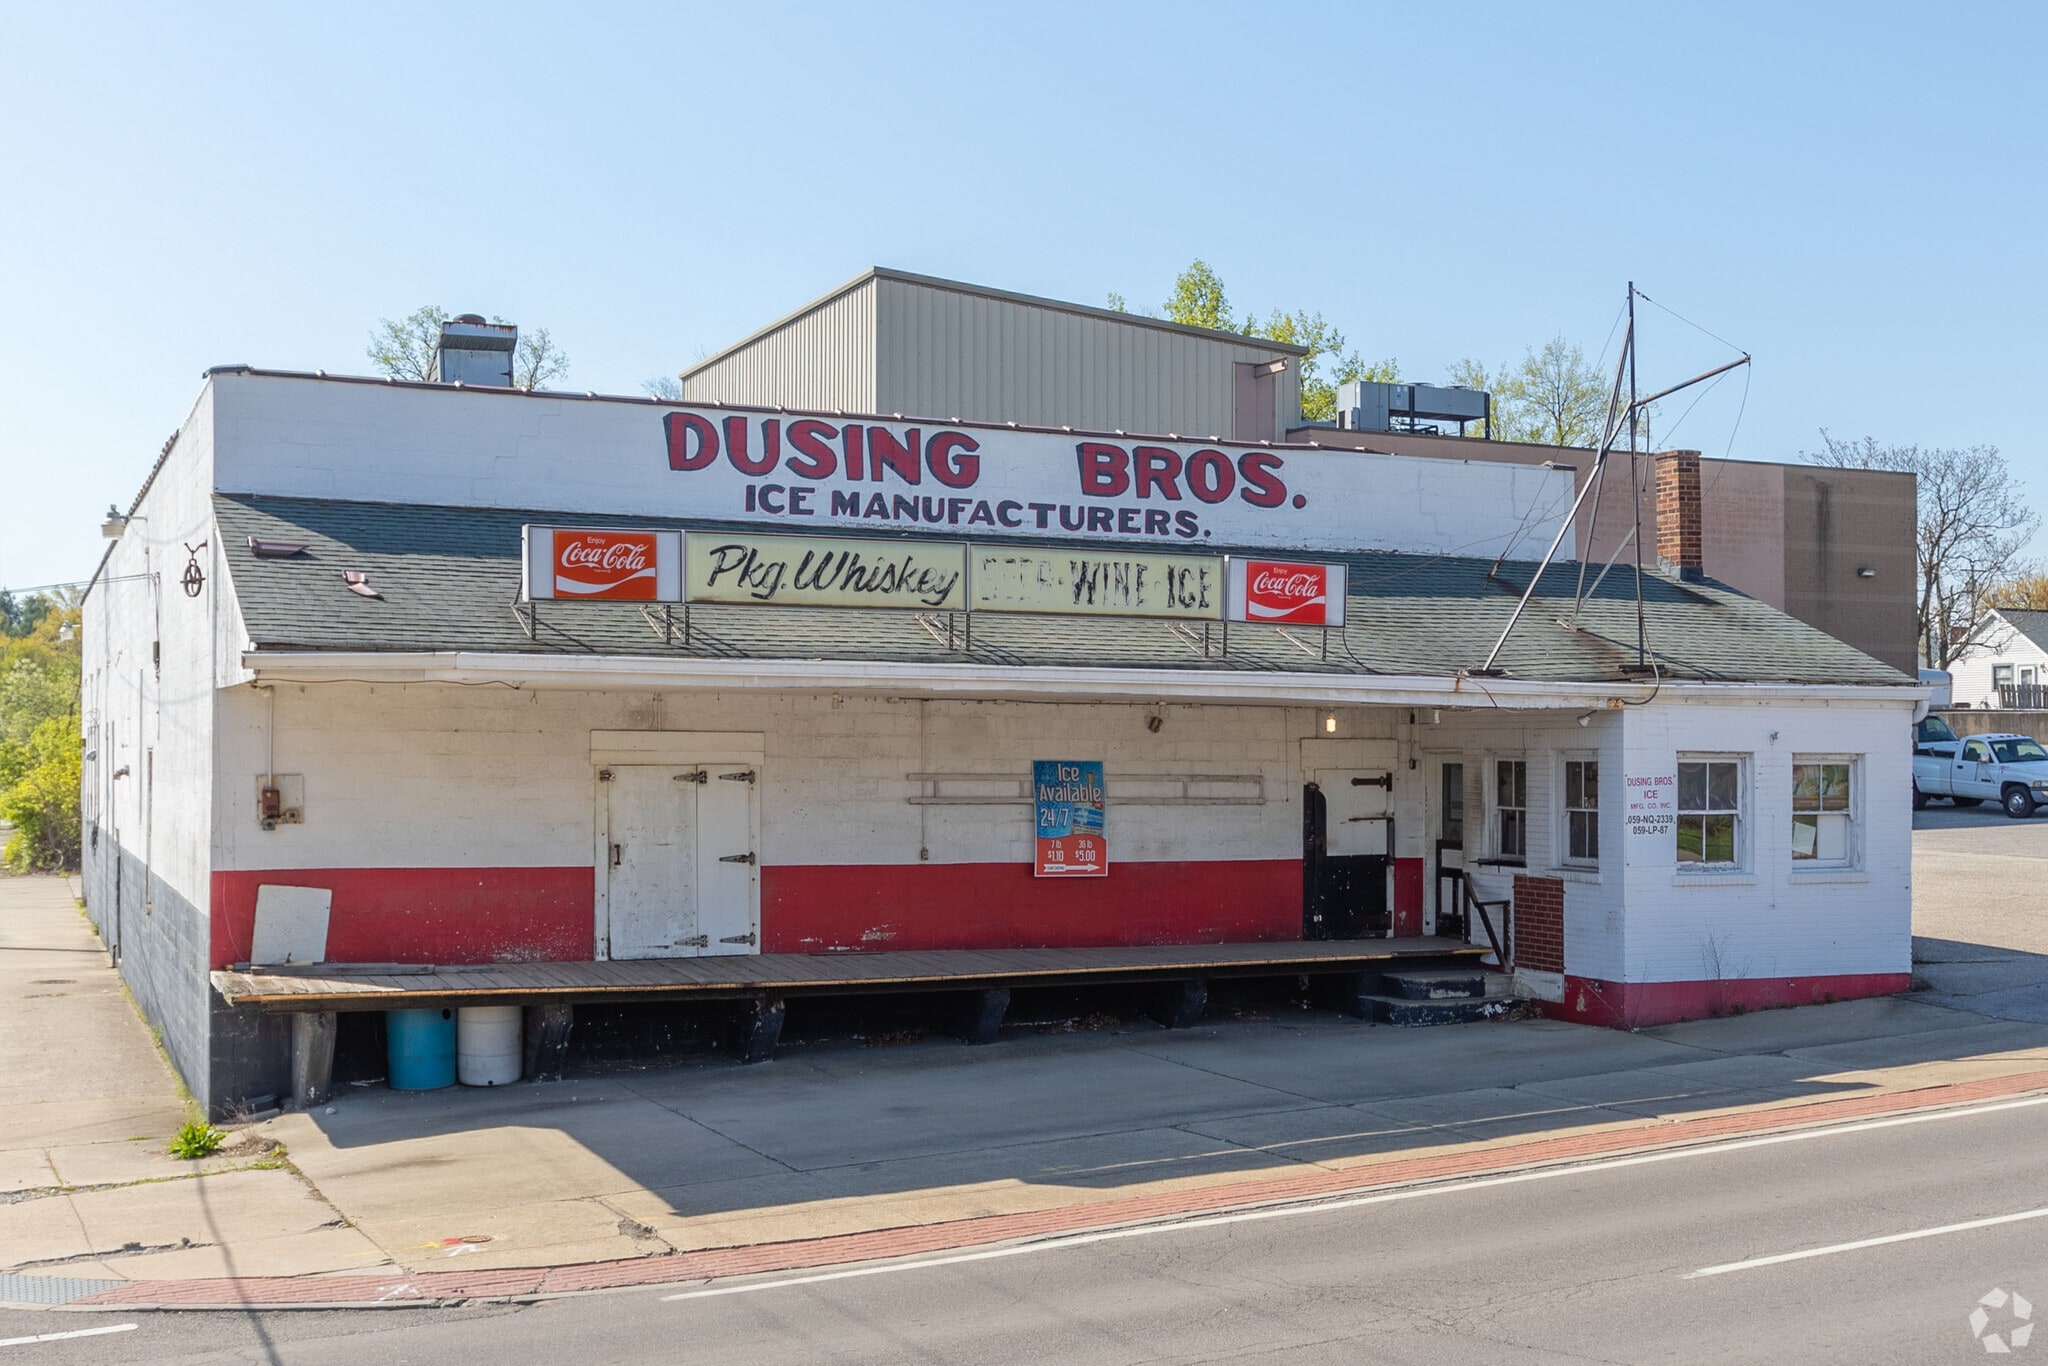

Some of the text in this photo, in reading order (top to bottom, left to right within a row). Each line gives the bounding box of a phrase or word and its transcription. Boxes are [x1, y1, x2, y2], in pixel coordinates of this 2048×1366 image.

[663, 411, 1306, 509] DUSING BROS.
[745, 484, 1212, 538] ICE MANUFACTURERS.
[587, 536, 606, 545] Enjoy
[561, 541, 649, 570] Coca-Cola
[707, 544, 787, 600] Pkg.
[794, 550, 959, 606] Whiskey
[1253, 571, 1320, 597] Coca-Cola
[1070, 560, 1148, 606] WINE
[1167, 564, 1212, 609] ICE
[1057, 763, 1079, 781] Ice
[1627, 777, 1652, 786] DUSING
[1039, 783, 1102, 802] Available
[1643, 790, 1658, 798] ICE
[1040, 808, 1069, 827] 24/7
[1628, 815, 1673, 824] 059-NQ-2339
[1633, 826, 1668, 835] 059-LP-87
[1047, 850, 1064, 862] $1.10
[1075, 850, 1096, 862] $5.00
